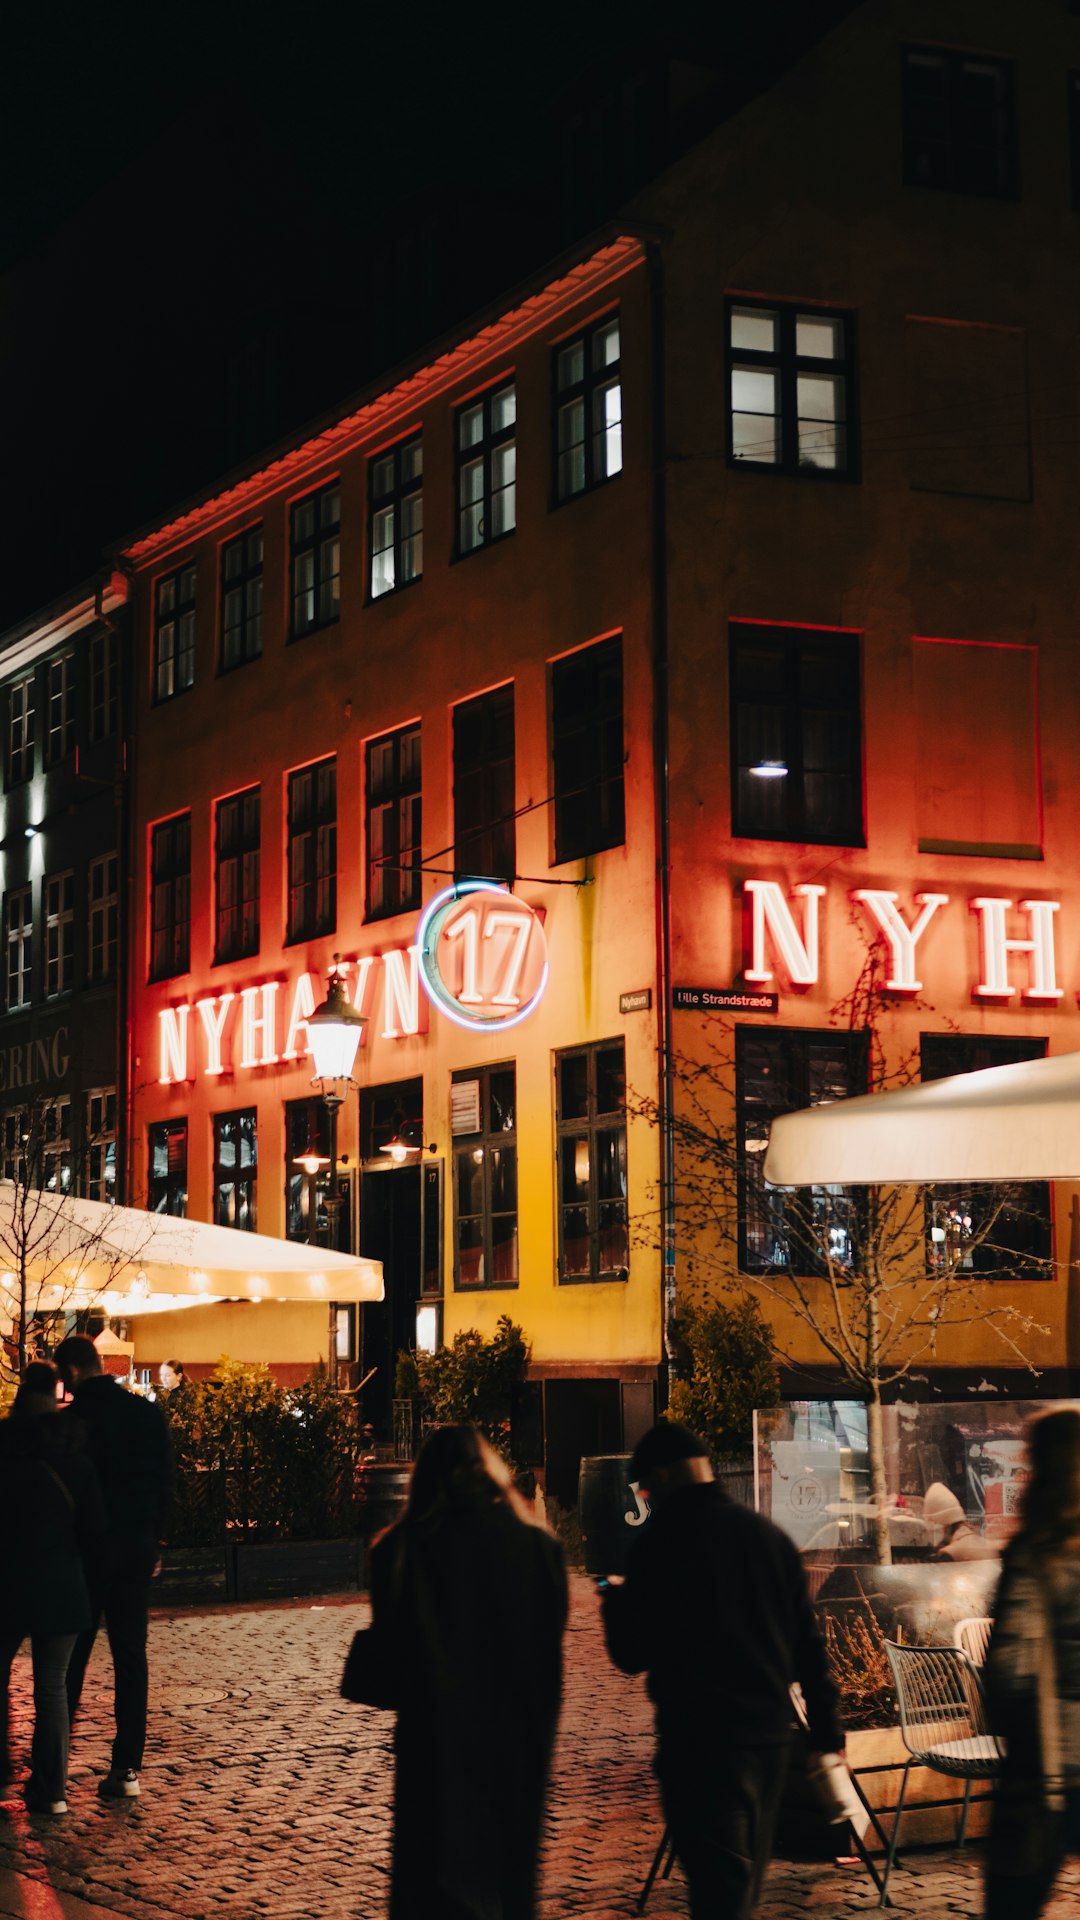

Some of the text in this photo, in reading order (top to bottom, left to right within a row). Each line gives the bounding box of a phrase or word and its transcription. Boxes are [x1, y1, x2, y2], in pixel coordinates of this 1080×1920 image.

[446, 910, 533, 1006] 17
[621, 995, 647, 1009] Nyhavn
[677, 991, 773, 1008] Lille Strandstræde
